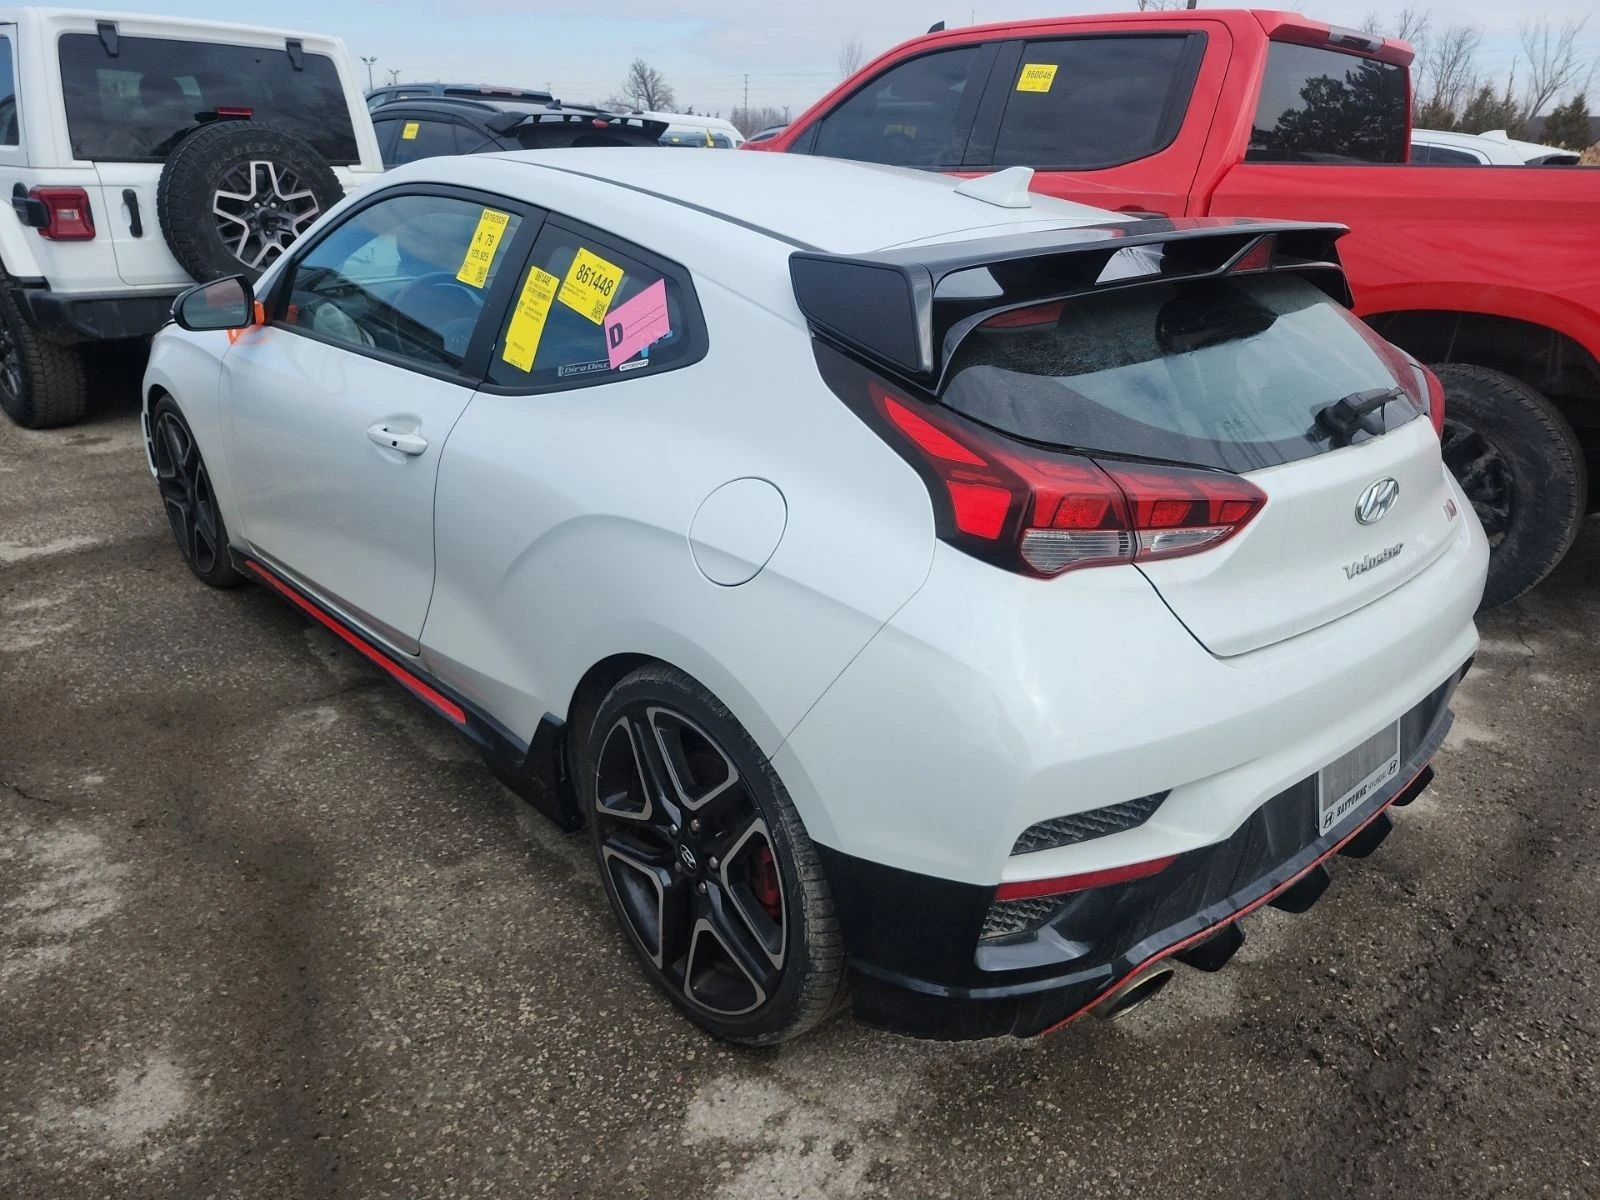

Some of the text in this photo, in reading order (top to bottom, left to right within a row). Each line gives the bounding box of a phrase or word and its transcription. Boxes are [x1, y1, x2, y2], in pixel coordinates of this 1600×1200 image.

[476, 231, 495, 247] A 79
[576, 263, 614, 297] 861448
[609, 322, 624, 350] D
[1341, 542, 1404, 580] Veloster
